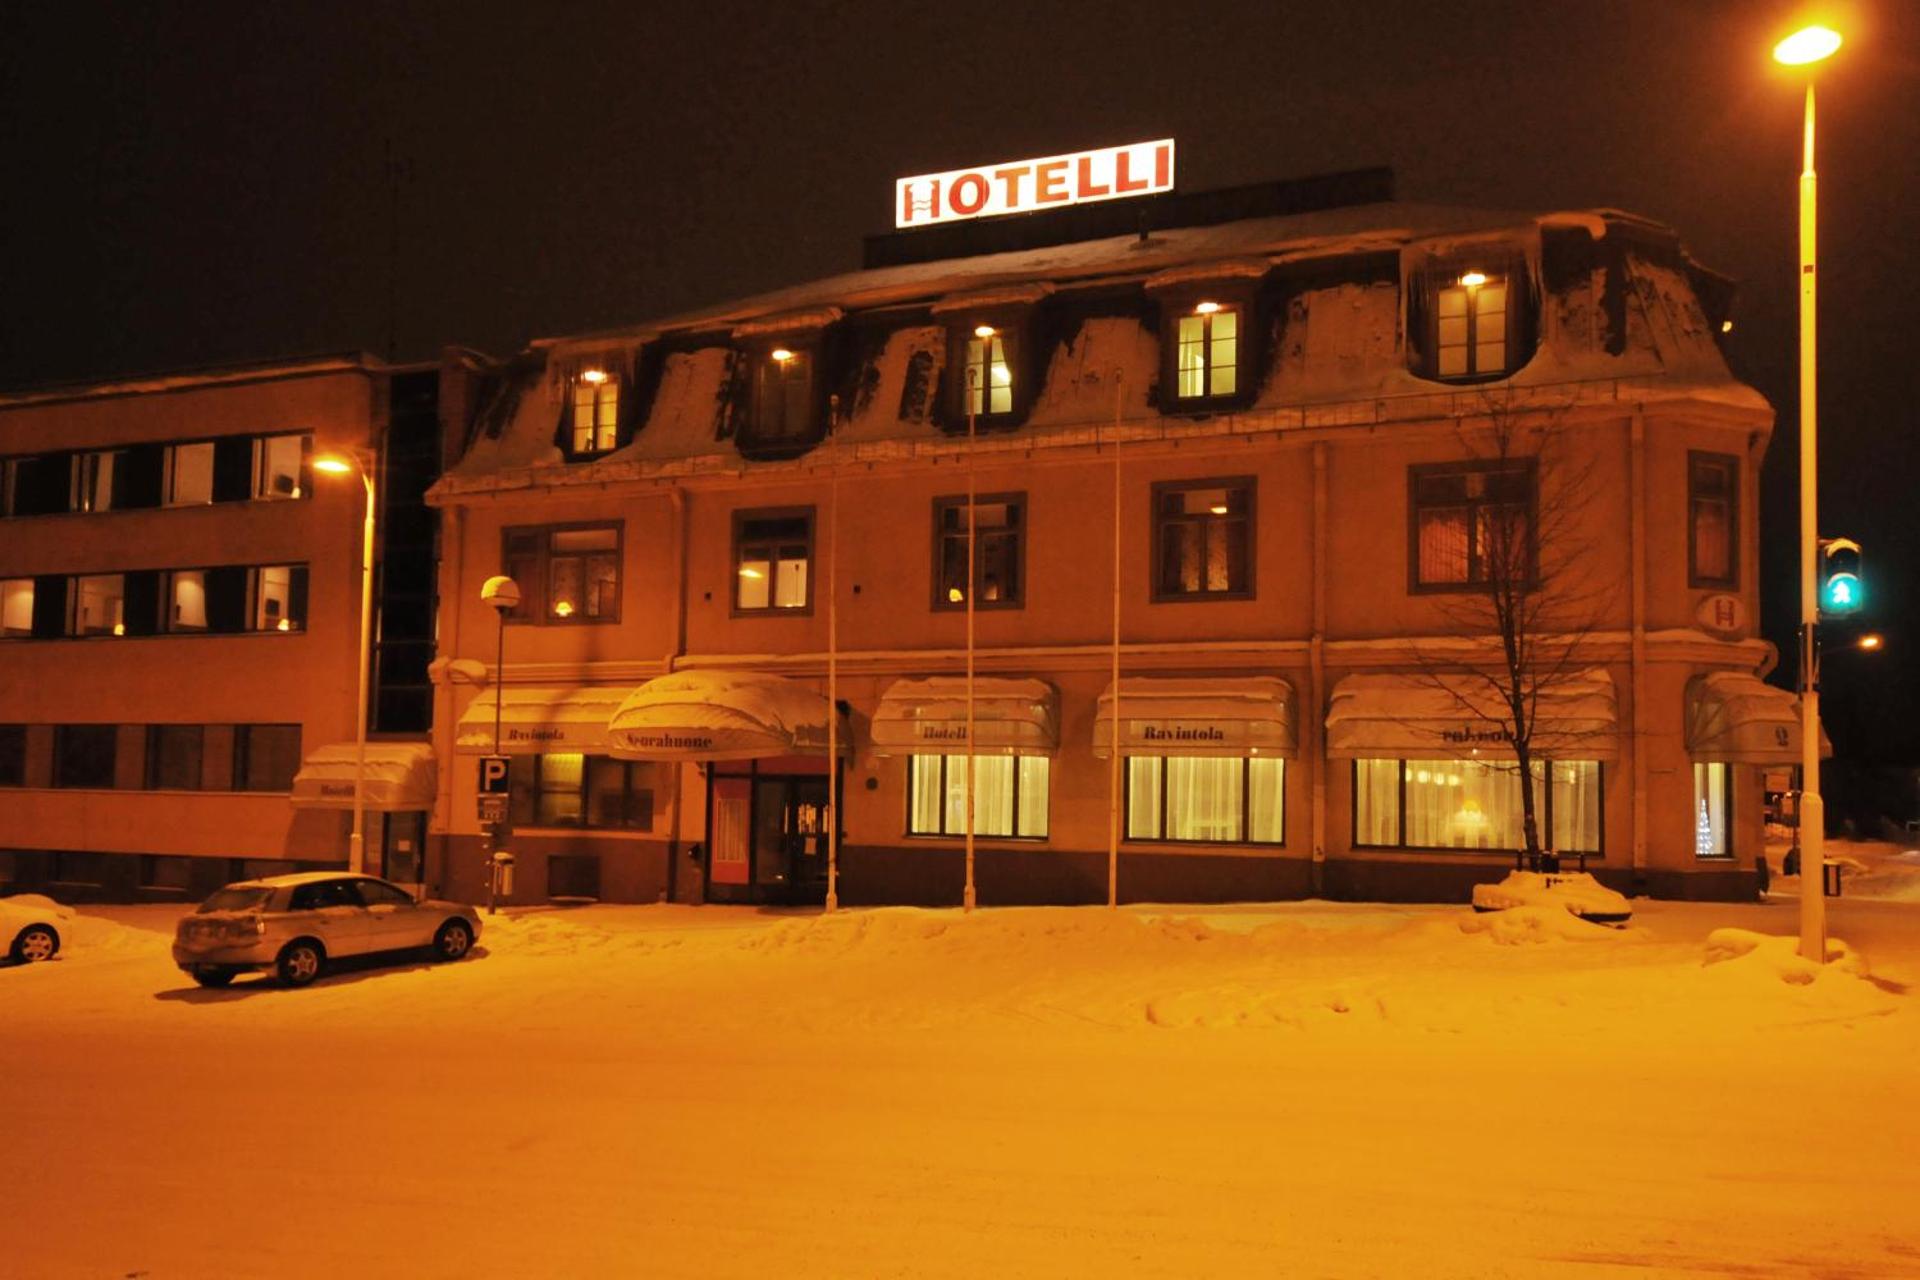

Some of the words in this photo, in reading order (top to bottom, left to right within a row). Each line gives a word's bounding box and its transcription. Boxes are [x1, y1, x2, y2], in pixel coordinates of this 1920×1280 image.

[904, 145, 1170, 222] HOTELLI
[923, 727, 969, 739] Hotell
[1144, 726, 1223, 740] Ravintola
[485, 759, 507, 791] P
